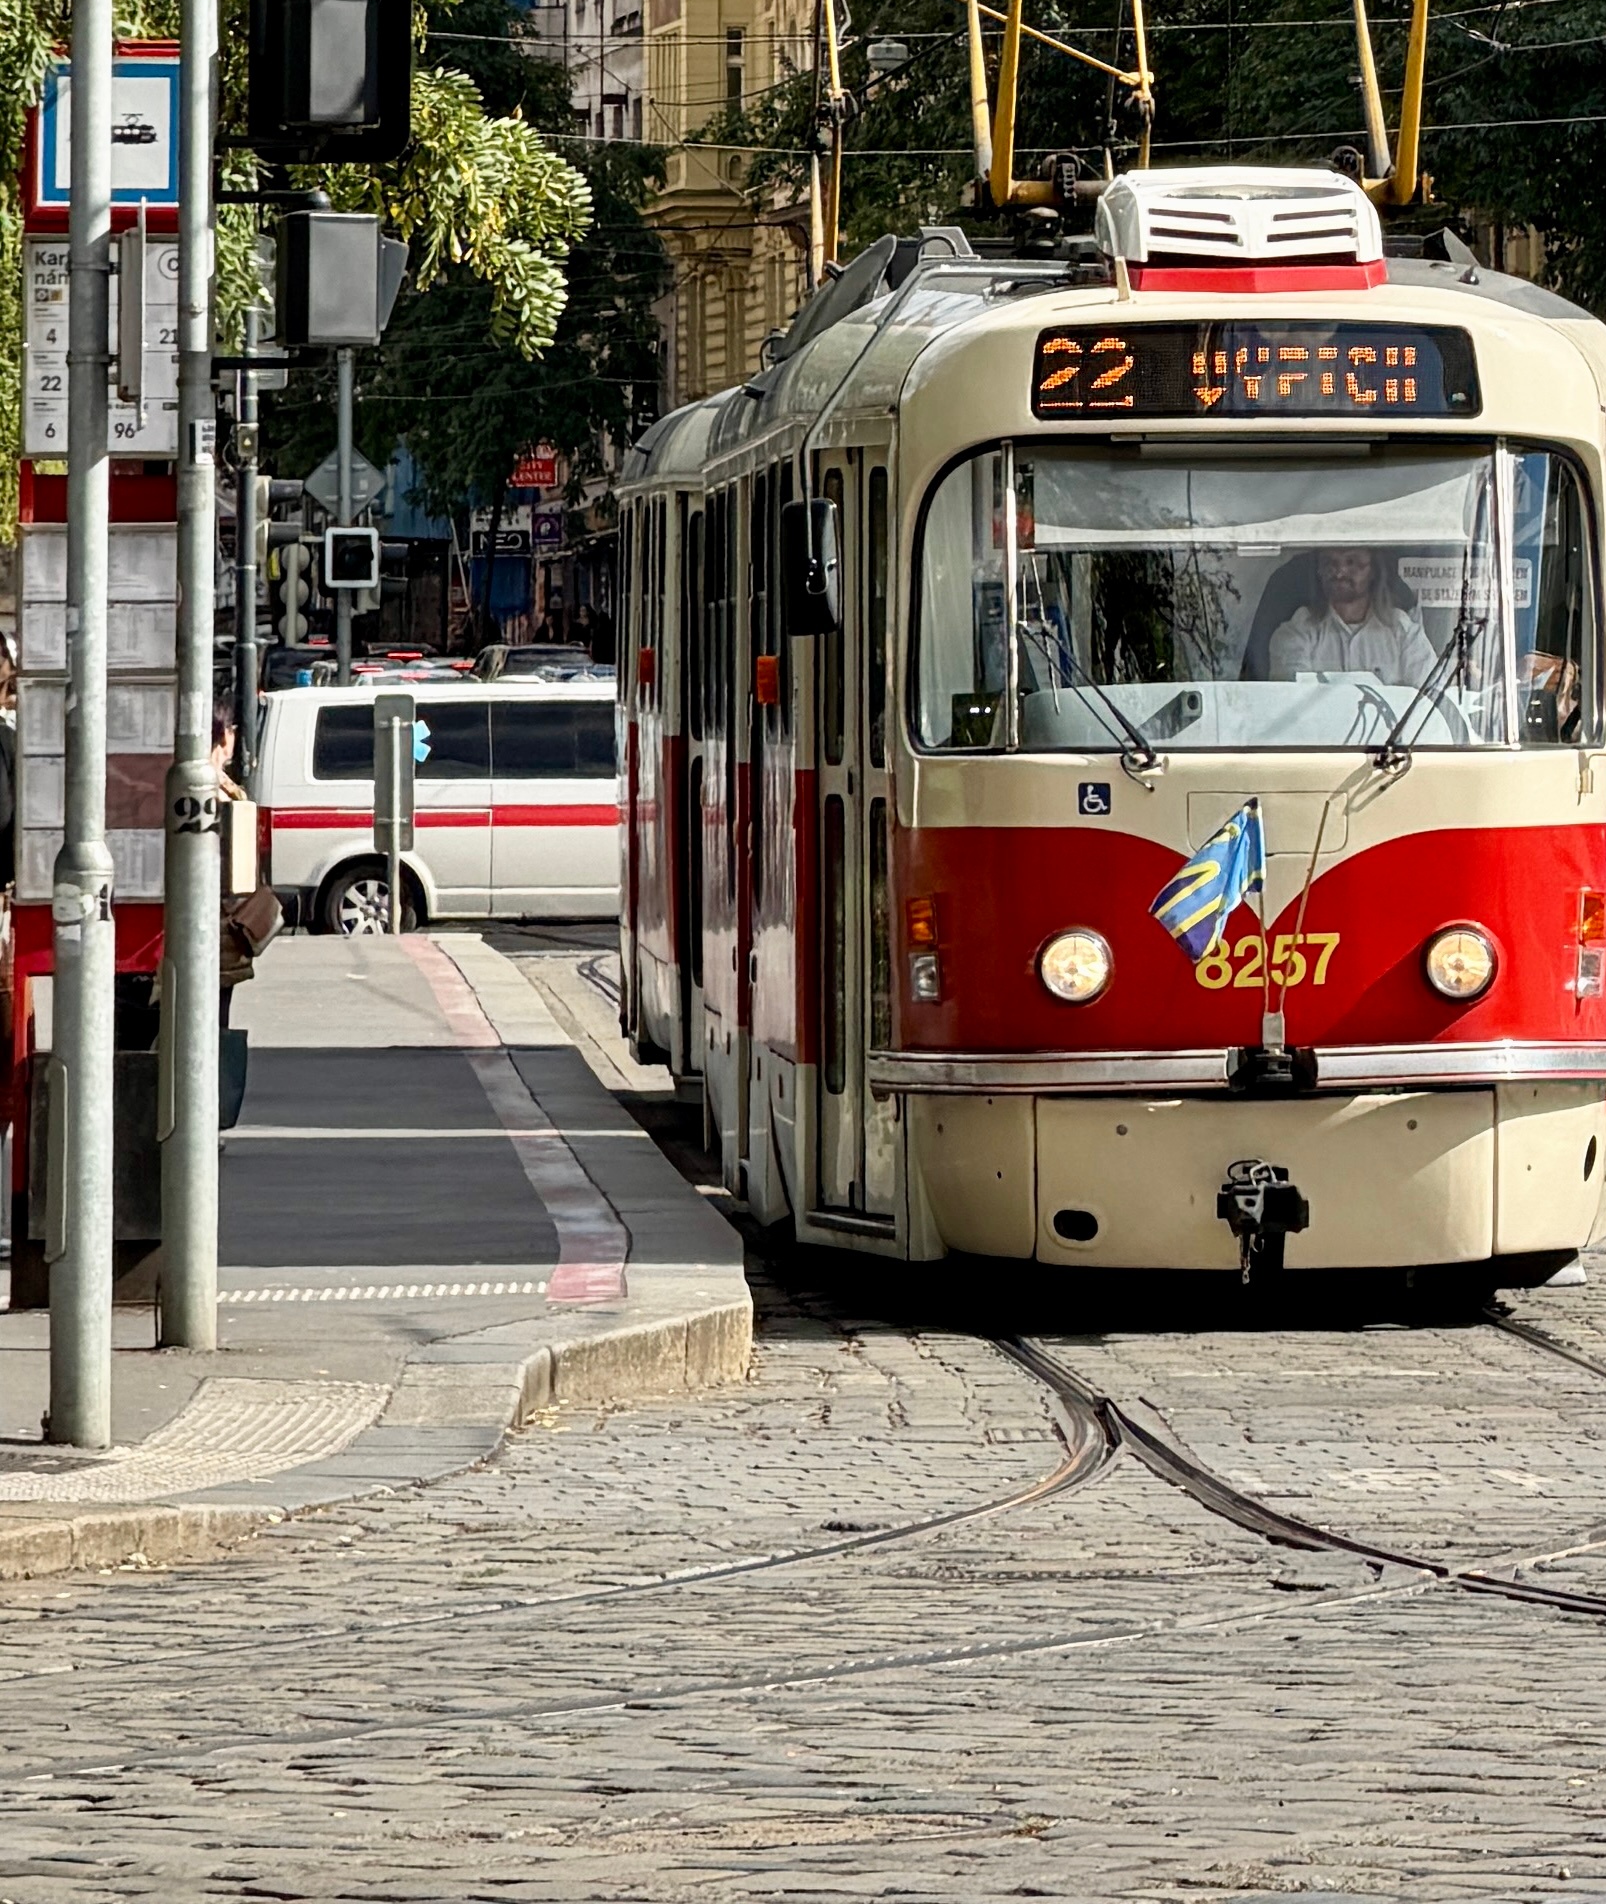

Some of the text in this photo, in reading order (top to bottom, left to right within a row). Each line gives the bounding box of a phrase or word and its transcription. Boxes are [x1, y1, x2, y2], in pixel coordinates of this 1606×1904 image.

[35, 250, 69, 267] Kar
[46, 328, 57, 344] 4
[159, 328, 178, 344] 21
[1040, 337, 1134, 407] 22
[40, 375, 62, 392] 22
[45, 422, 56, 439] 6
[114, 422, 135, 439] 96
[479, 532, 524, 550] NEO
[1195, 932, 1341, 990] 8257
